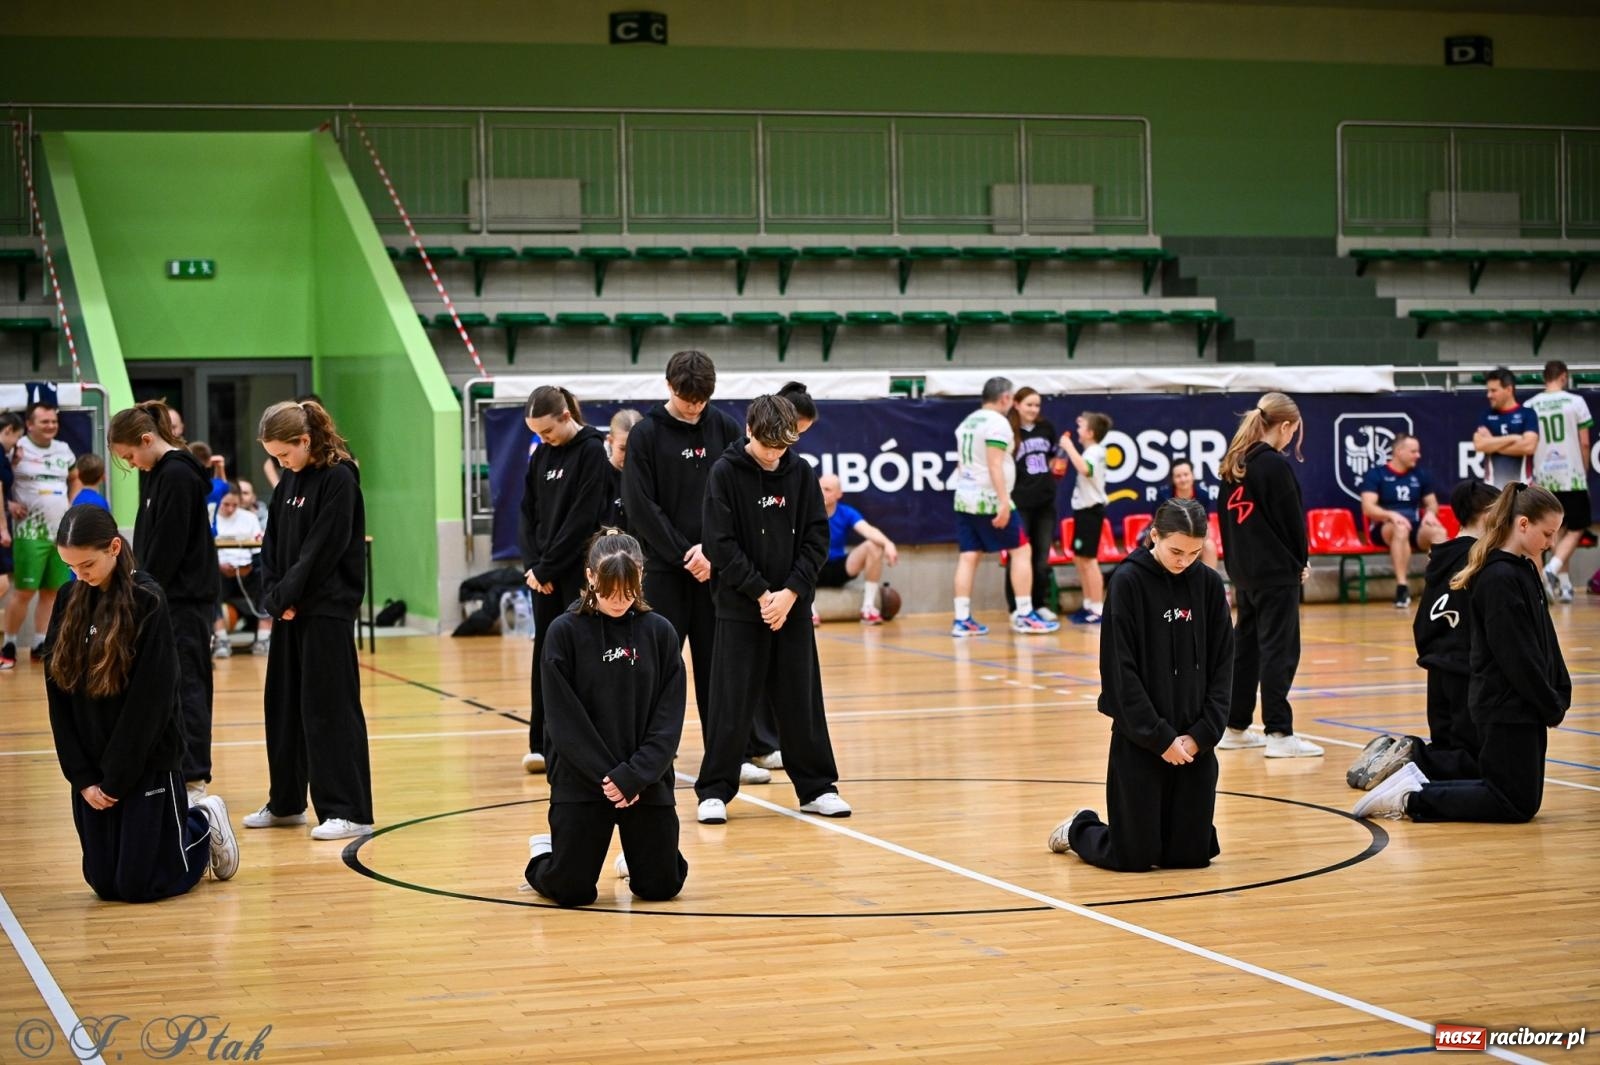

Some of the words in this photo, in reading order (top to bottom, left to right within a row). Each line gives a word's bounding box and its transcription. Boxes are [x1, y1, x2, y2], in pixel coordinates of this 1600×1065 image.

[615, 22, 639, 40] C
[1452, 46, 1476, 62] D
[1538, 413, 1565, 444] 10
[962, 432, 974, 464] 11
[1395, 485, 1411, 501] 12
